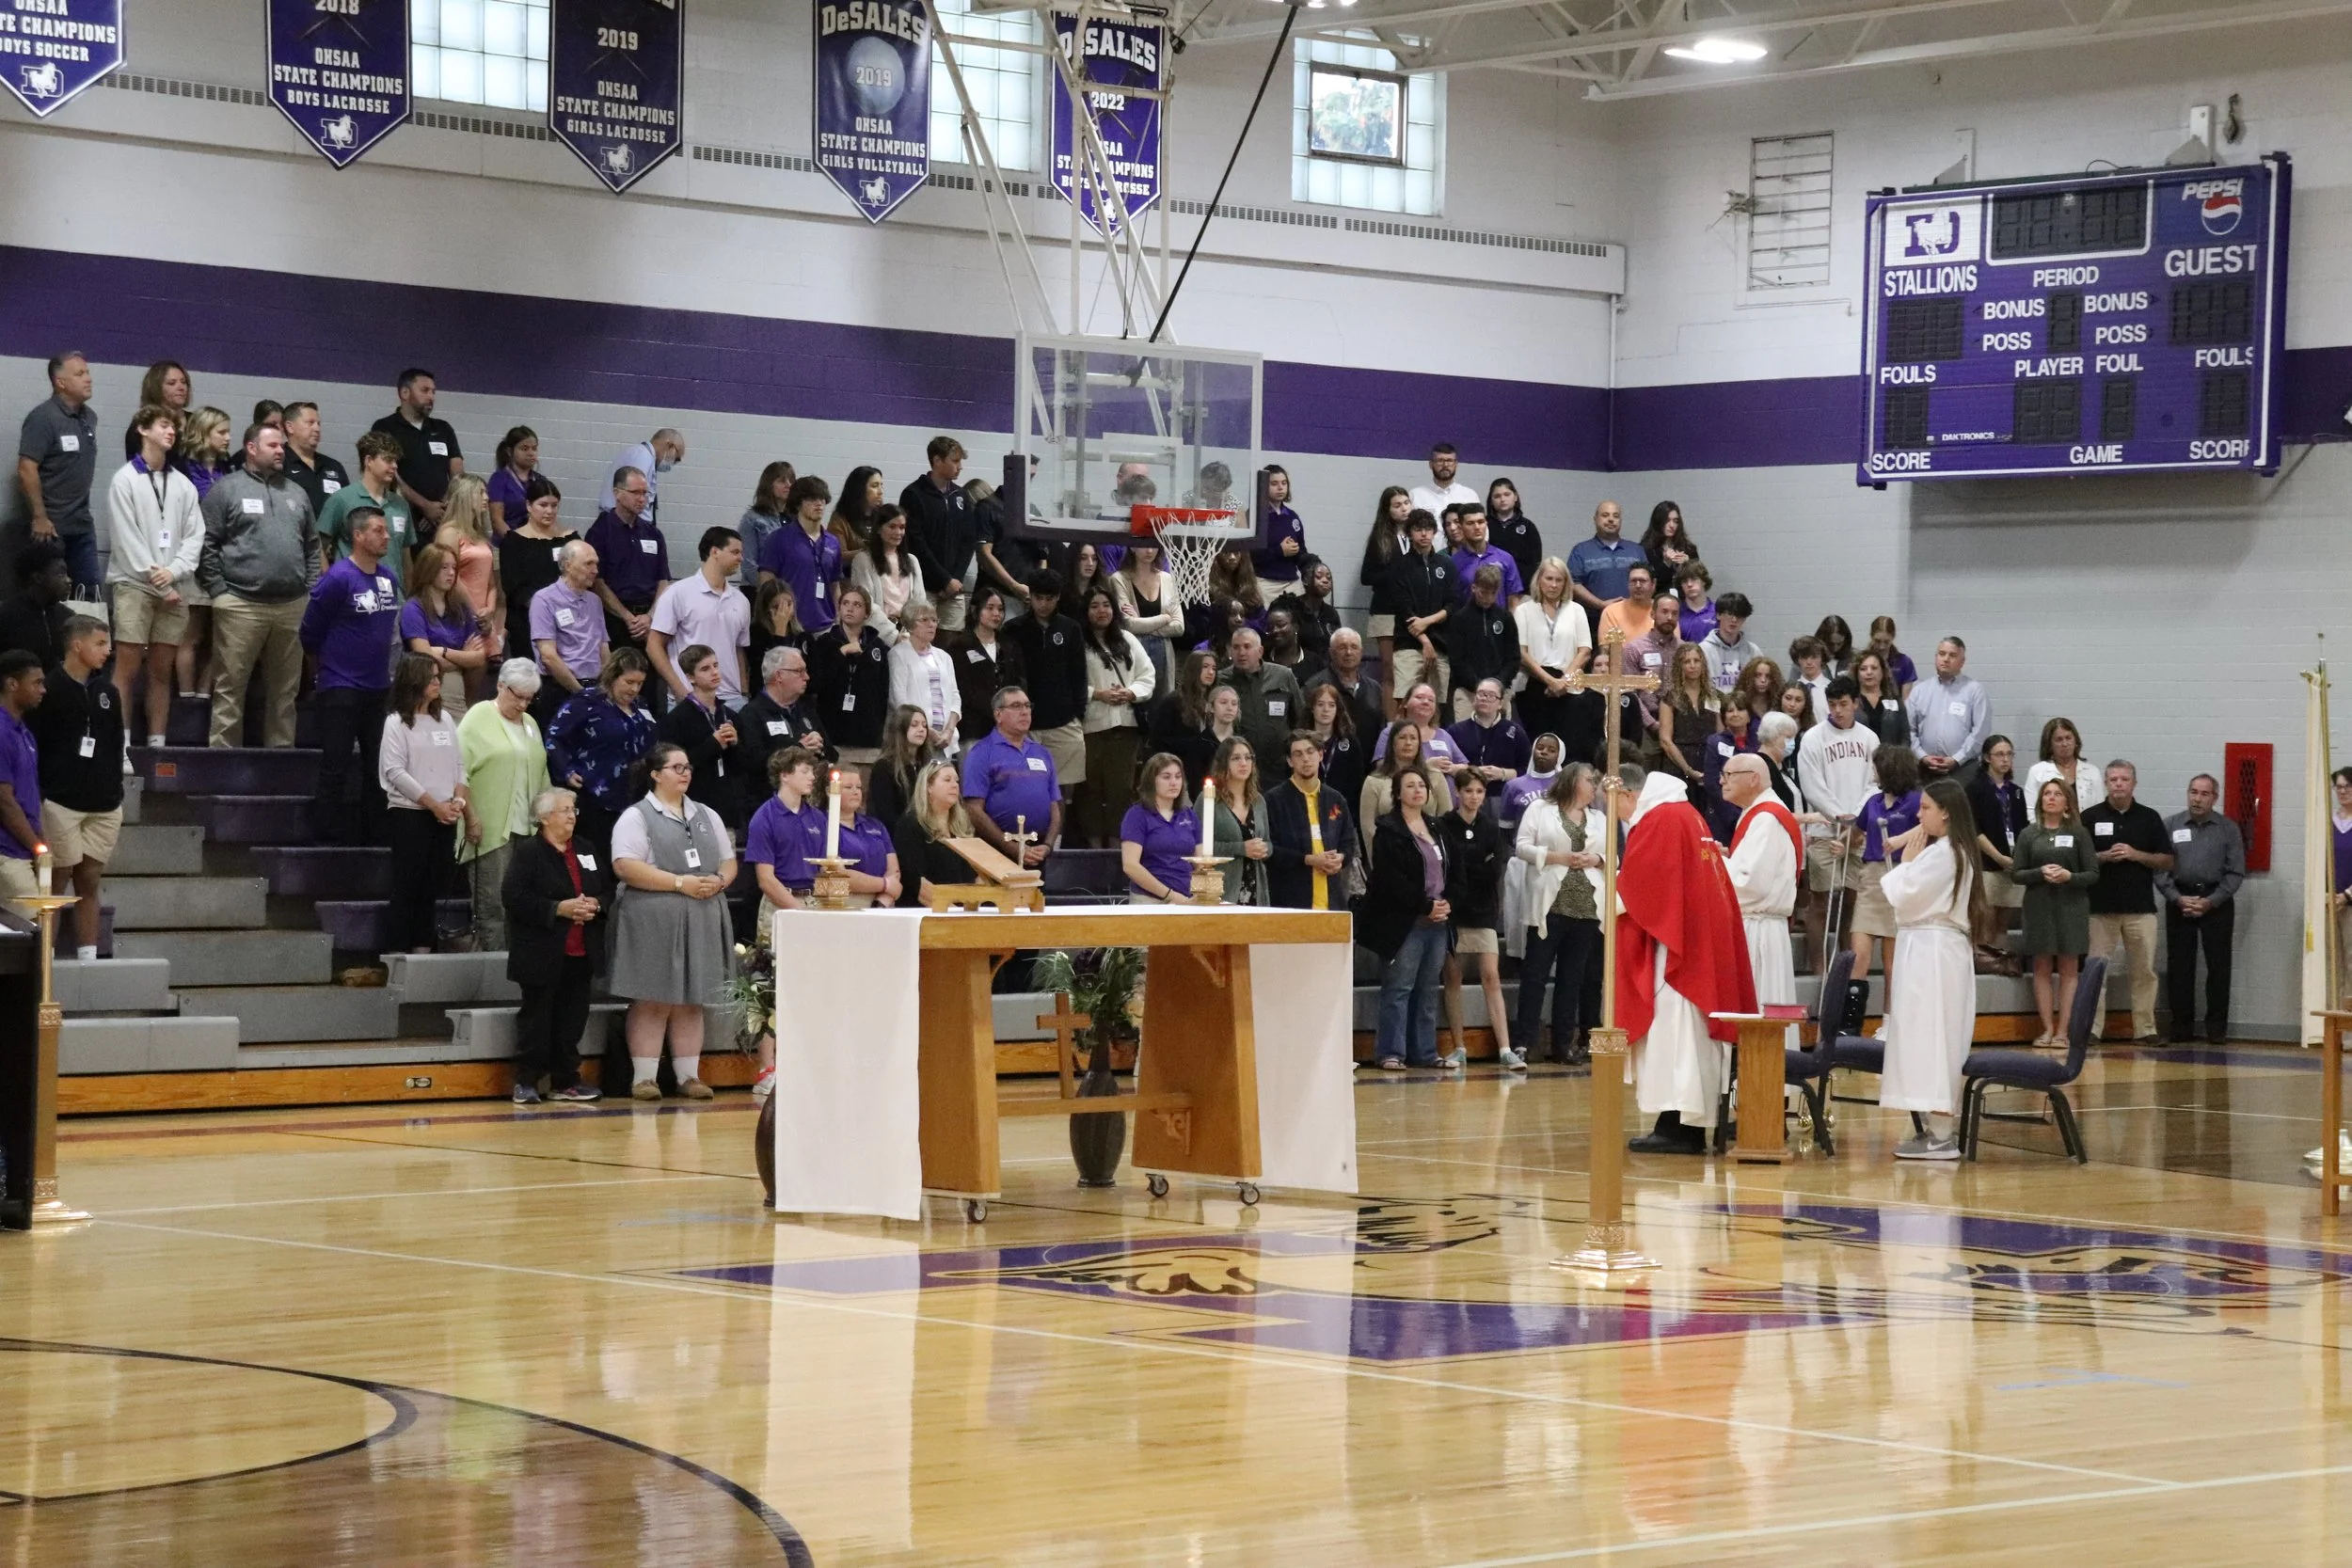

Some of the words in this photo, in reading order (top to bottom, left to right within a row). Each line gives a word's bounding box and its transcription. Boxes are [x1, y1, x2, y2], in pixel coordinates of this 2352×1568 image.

[22, 16, 116, 43] CHAMPIONS
[822, 1, 924, 47] DeSALES
[597, 27, 638, 50] 2019
[1058, 27, 1156, 72] DSALES
[0, 38, 31, 55] OYS
[35, 41, 89, 62] SOCCER
[315, 47, 360, 69] OHSAA
[274, 64, 318, 86] STATE
[323, 71, 404, 95] CHAMPIONS
[856, 66, 892, 87] 2019
[597, 80, 638, 101] OHSAA
[1090, 90, 1125, 111] 2022
[287, 89, 320, 106] BOYS
[324, 94, 390, 115] LACROSSE
[557, 96, 599, 116] STATE
[604, 102, 675, 126] CHAMPIONS
[566, 119, 603, 135] GIRLS
[607, 123, 666, 144] LACROSSE
[855, 117, 893, 135] OHSAA
[820, 133, 857, 151] STATE
[862, 136, 926, 158] CHAMPIONS
[822, 153, 854, 169] GIRLS
[857, 157, 924, 176] VOLLEYBALL
[1094, 159, 1154, 179] AMPIONS
[2182, 178, 2244, 200] PEPSI
[2164, 245, 2258, 277] GUEST
[1884, 264, 1978, 297] STALLIONS
[2033, 266, 2099, 287] PERIOD
[1983, 298, 2045, 320] BONUS
[2084, 292, 2148, 313] BONUS
[1982, 331, 2032, 352] POSS
[2095, 324, 2147, 344] POSS
[2014, 356, 2084, 377] PLAYER
[2095, 353, 2144, 373] FOUL
[2195, 346, 2254, 368] FOULS
[1881, 364, 1936, 385] FOULS
[1942, 432, 1994, 441] DAKTRONICS
[1872, 452, 1931, 471] SCORE
[2070, 444, 2123, 465] GAME
